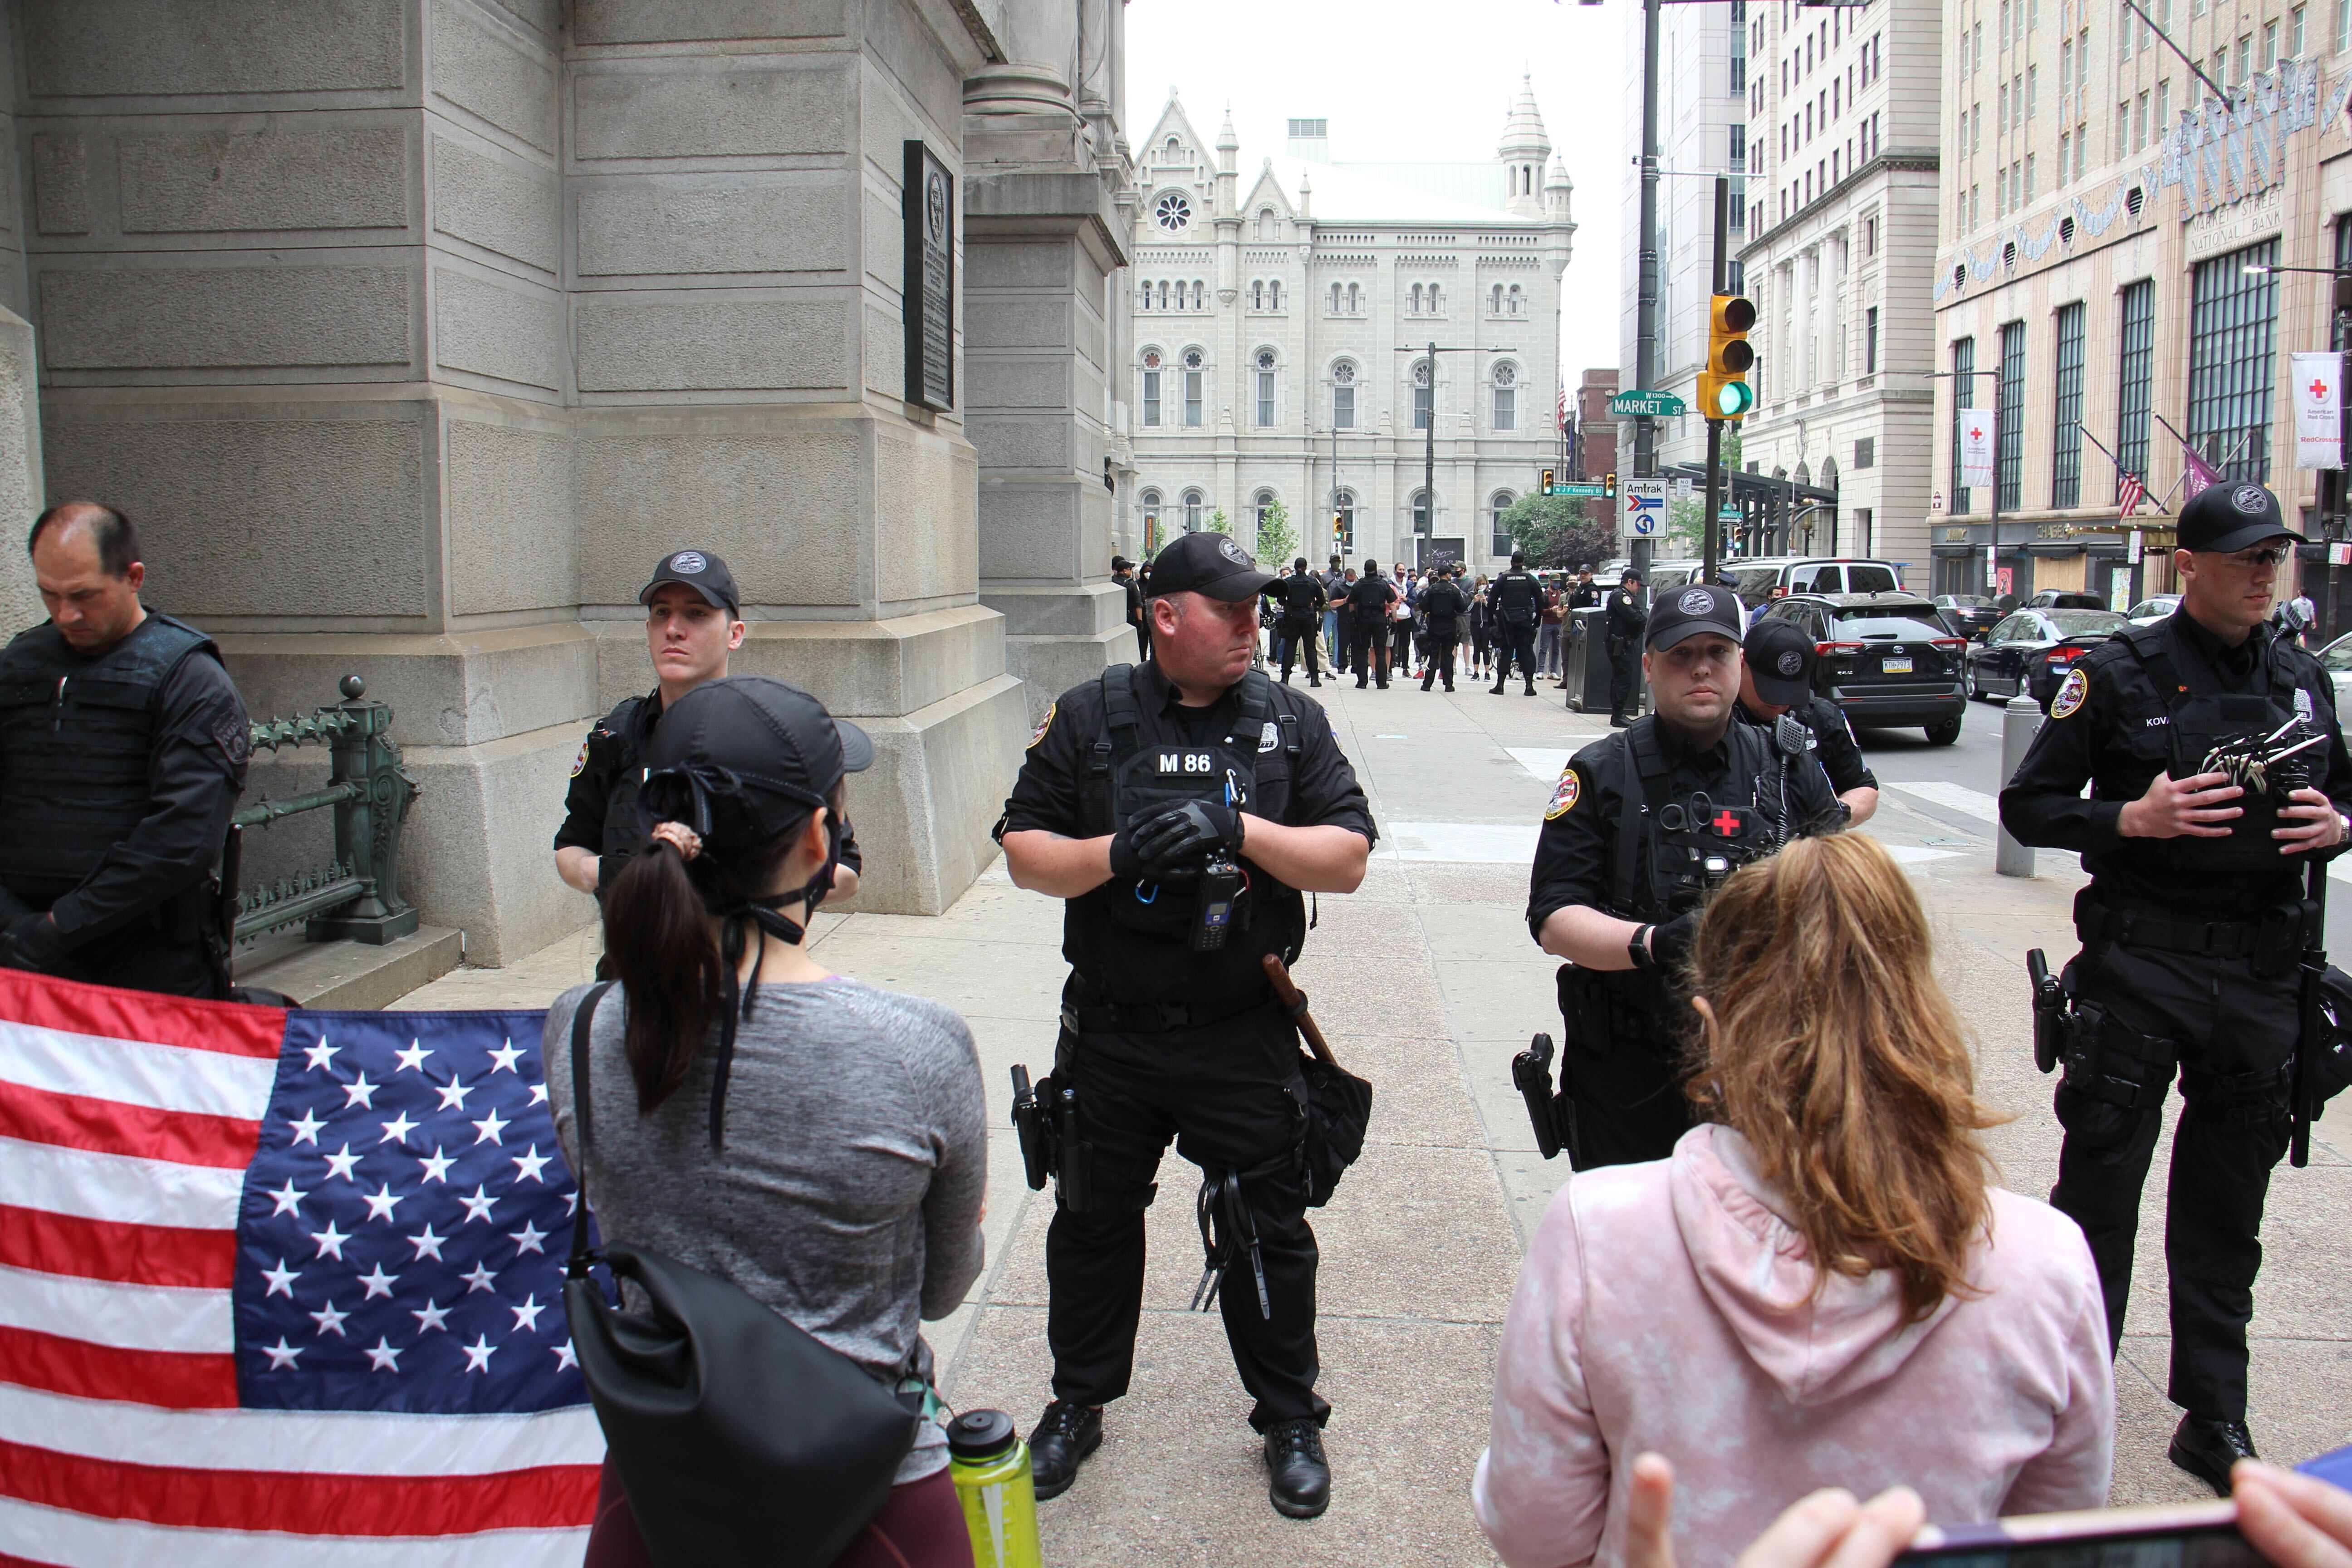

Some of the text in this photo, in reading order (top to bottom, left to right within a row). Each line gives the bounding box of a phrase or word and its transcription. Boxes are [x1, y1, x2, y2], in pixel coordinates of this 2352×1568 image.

[2192, 189, 2282, 233] MARKET STREET
[2192, 209, 2281, 252] NATIONAL BANK
[1615, 399, 1682, 415] MARKET ST
[1627, 484, 1662, 493] Amtrak
[2037, 525, 2063, 539] CHASE
[1160, 754, 1210, 772] M 86
